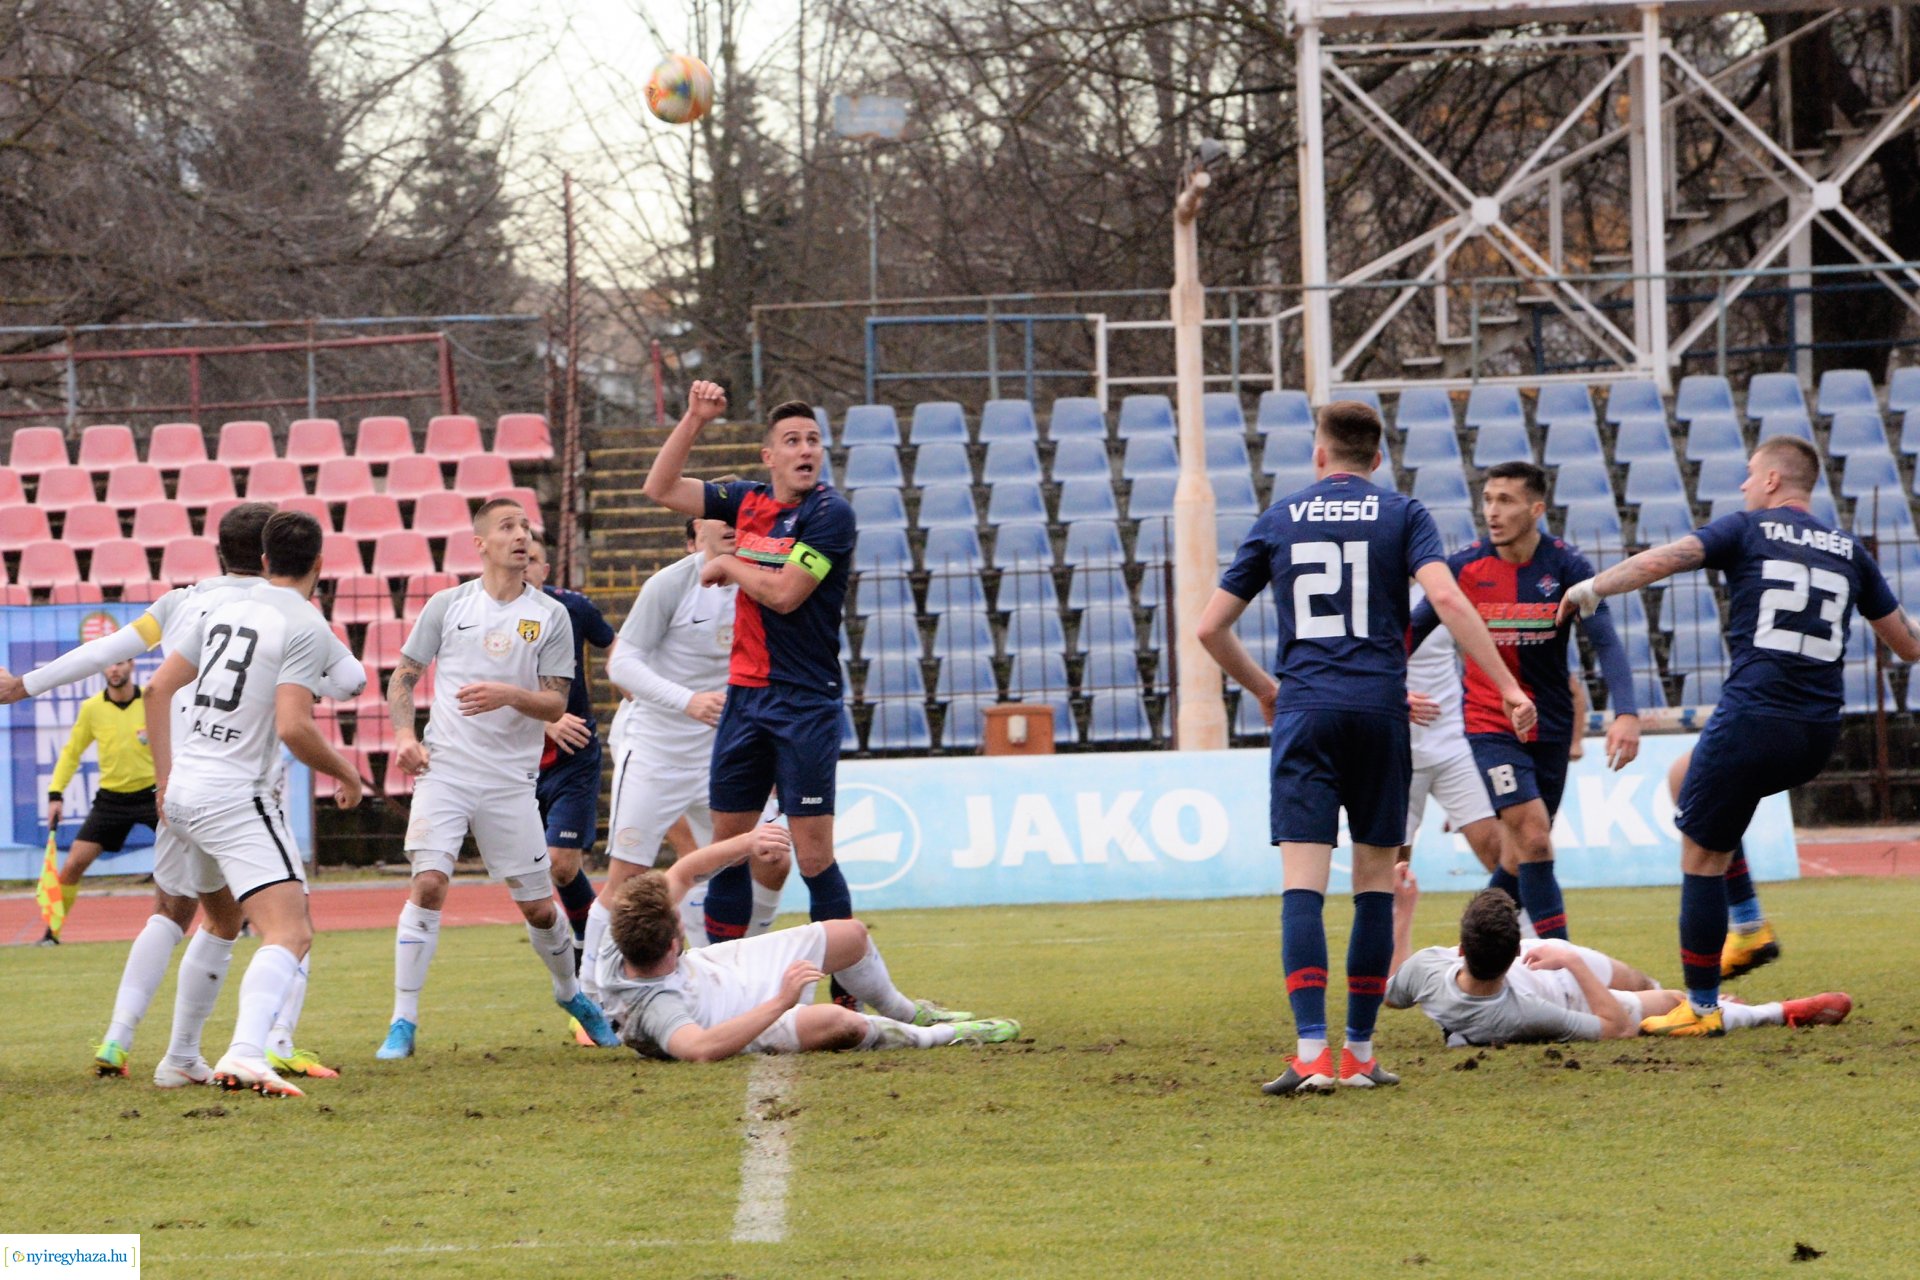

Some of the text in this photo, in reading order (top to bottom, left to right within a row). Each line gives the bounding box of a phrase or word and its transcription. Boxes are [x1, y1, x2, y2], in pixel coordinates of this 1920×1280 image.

[800, 550, 818, 570] C
[1759, 521, 1854, 560] TALABÉR
[1290, 541, 1369, 639] 21
[1753, 559, 1850, 662] 23
[194, 623, 258, 712] 23
[952, 788, 1230, 869] JAKO
